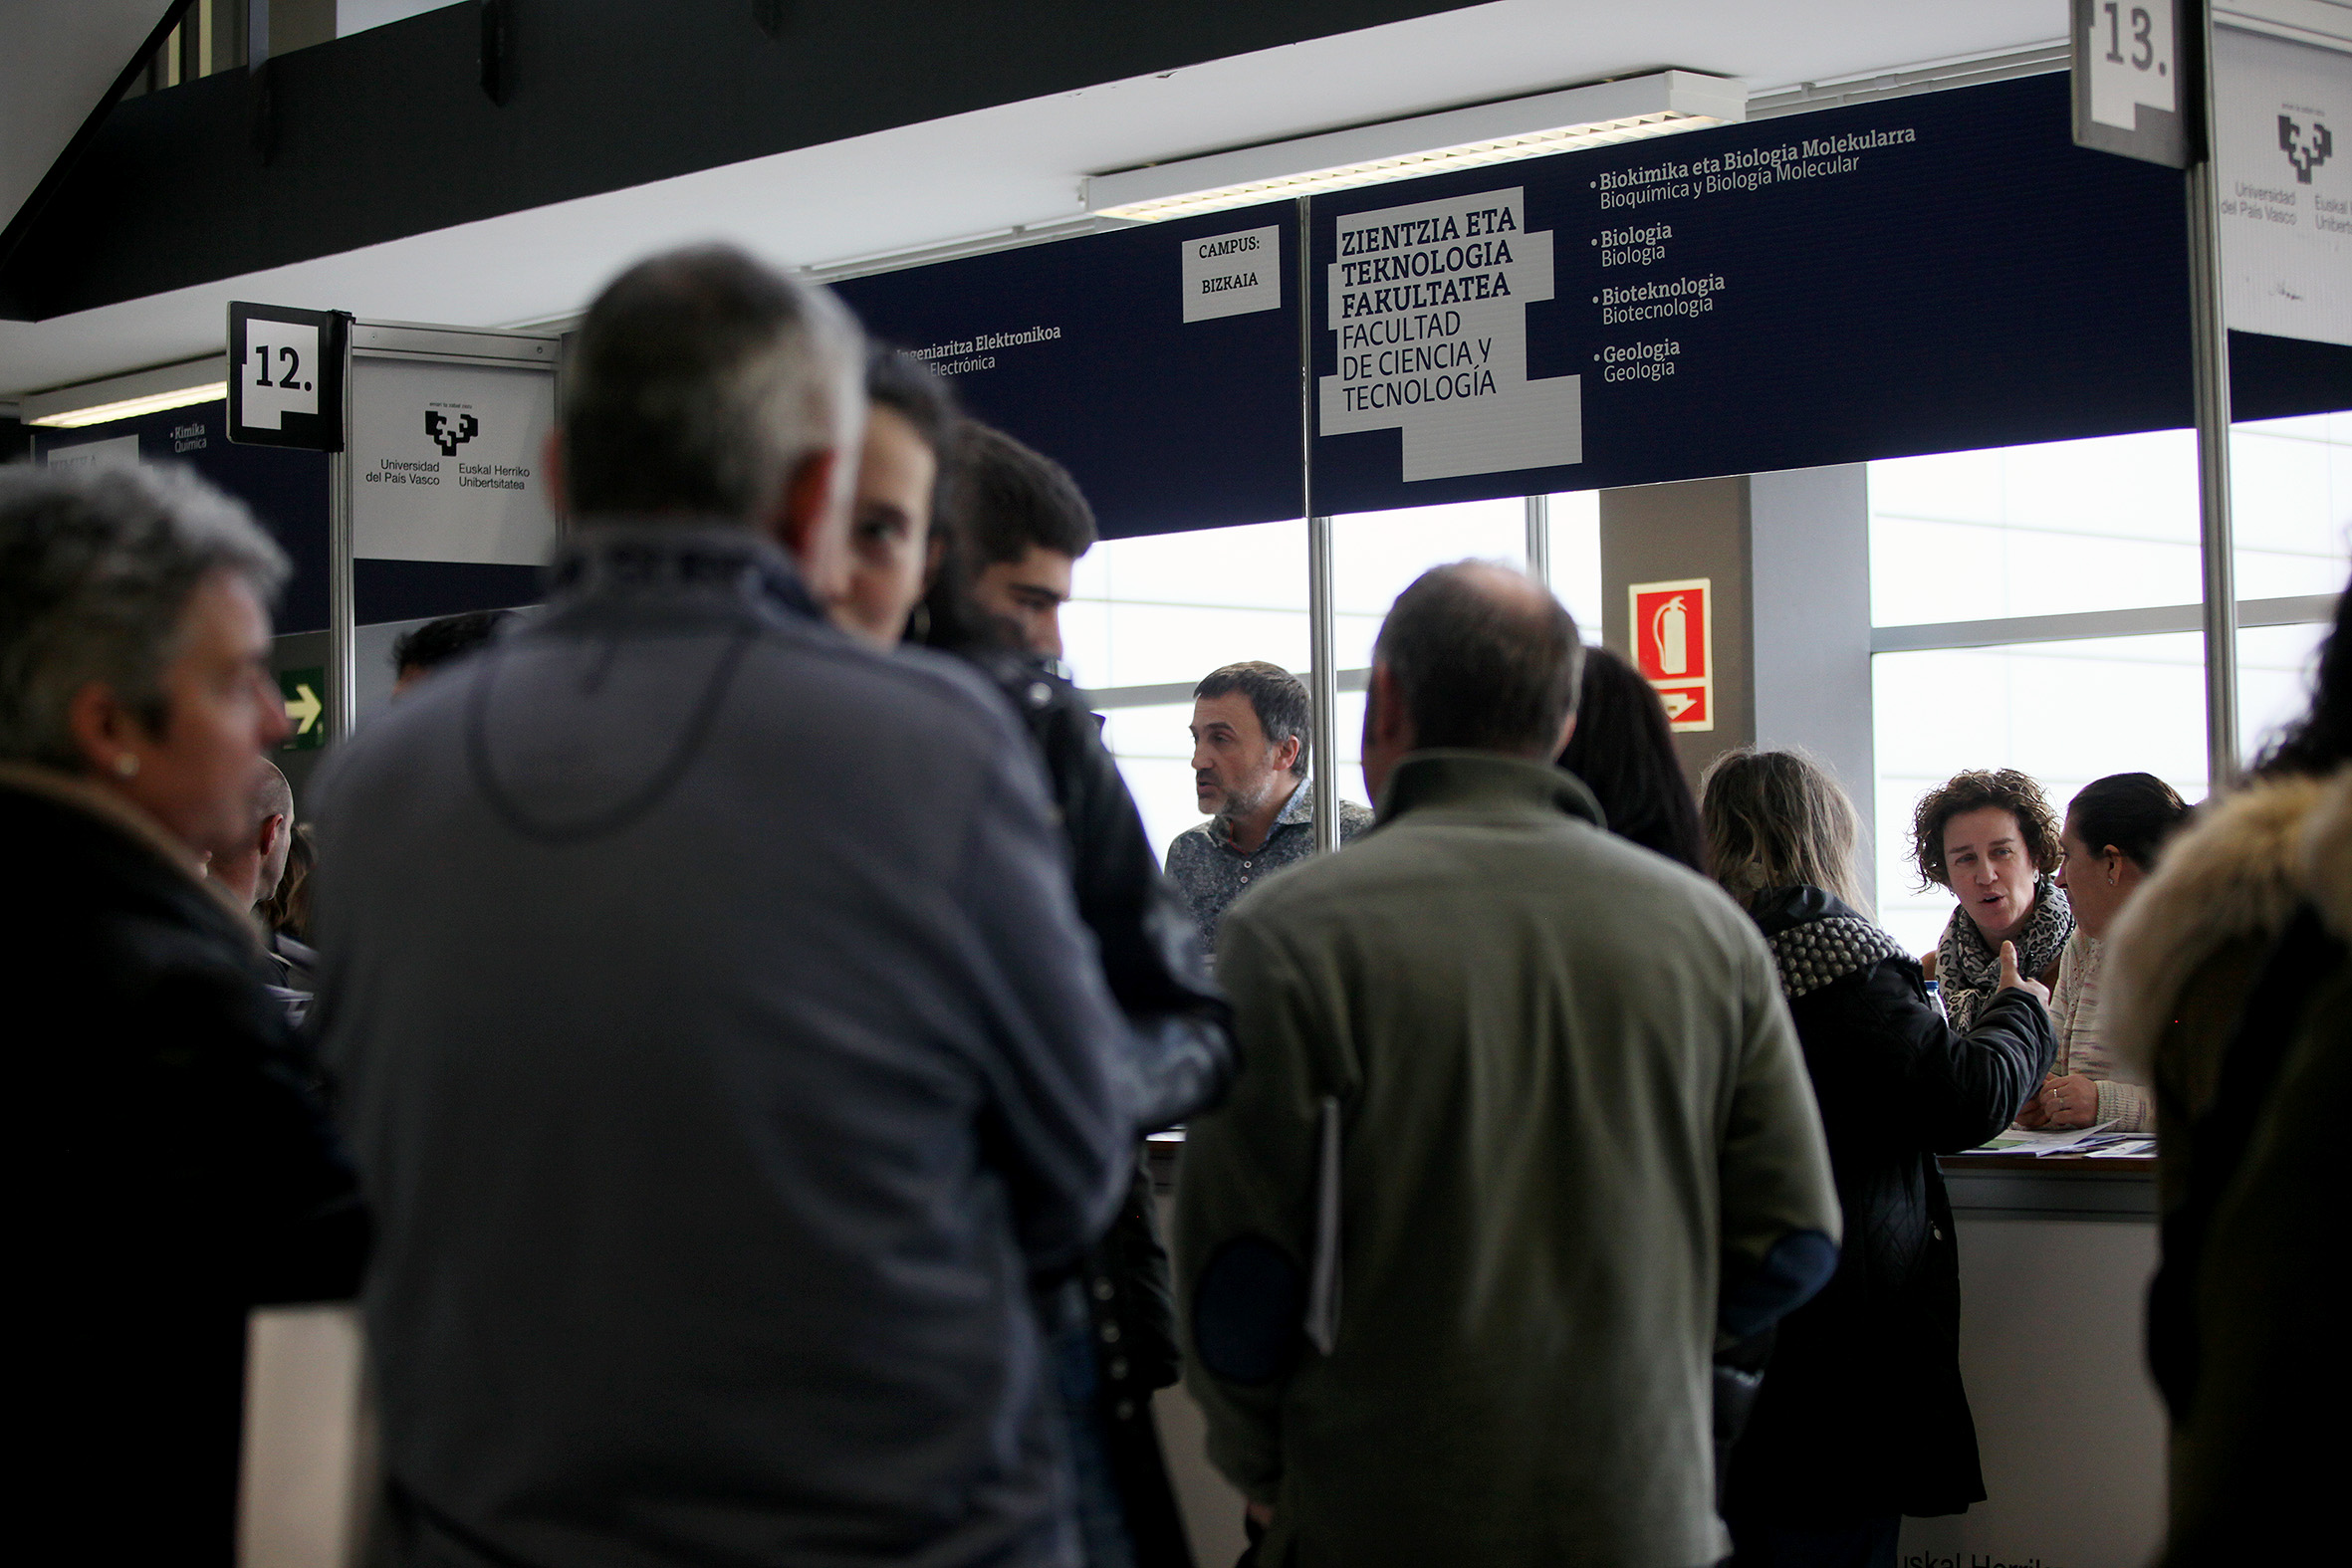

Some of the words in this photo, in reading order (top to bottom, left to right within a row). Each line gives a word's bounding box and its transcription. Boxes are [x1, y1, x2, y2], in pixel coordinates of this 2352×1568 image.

[2103, 2, 2167, 77] 13.
[1599, 161, 1690, 191] Biokimika
[1692, 157, 1721, 175] eta
[1724, 143, 1798, 171] Biologia
[1801, 127, 1916, 159] Molekularra
[1600, 184, 1690, 210] Bioquímica
[1693, 180, 1703, 199] y
[1706, 167, 1772, 191] Biología
[1776, 155, 1860, 183] Molecular
[1341, 216, 1460, 257] ZIENTZIA
[1466, 206, 1517, 236] ETA
[1600, 222, 1673, 248] Biologia
[1199, 236, 1261, 259] CAMPUS:
[1341, 239, 1514, 288] TEKNOLOGIA
[1201, 271, 1259, 295] BIZKAIA
[1341, 271, 1512, 319] FAKULTATEA
[1601, 273, 1726, 307] Bioteknologia
[975, 326, 1061, 352] Elektronikoa
[1342, 310, 1461, 350] FACULTAD
[1343, 353, 1372, 381] DE
[1378, 339, 1473, 377] CIENCIA
[1603, 337, 1681, 363] Geologia
[255, 344, 313, 392] 12.
[929, 355, 996, 377] Electrónica
[1603, 357, 1676, 383] Geología
[1343, 364, 1498, 412] TECNOLOGÍA
[174, 422, 206, 440] Kimika
[365, 472, 381, 483] del
[408, 474, 440, 486] Vasco
[380, 459, 440, 473] Universidad
[458, 463, 492, 476] Euskal
[494, 465, 531, 478] Herriko
[459, 476, 526, 491] Unibertsitatea
